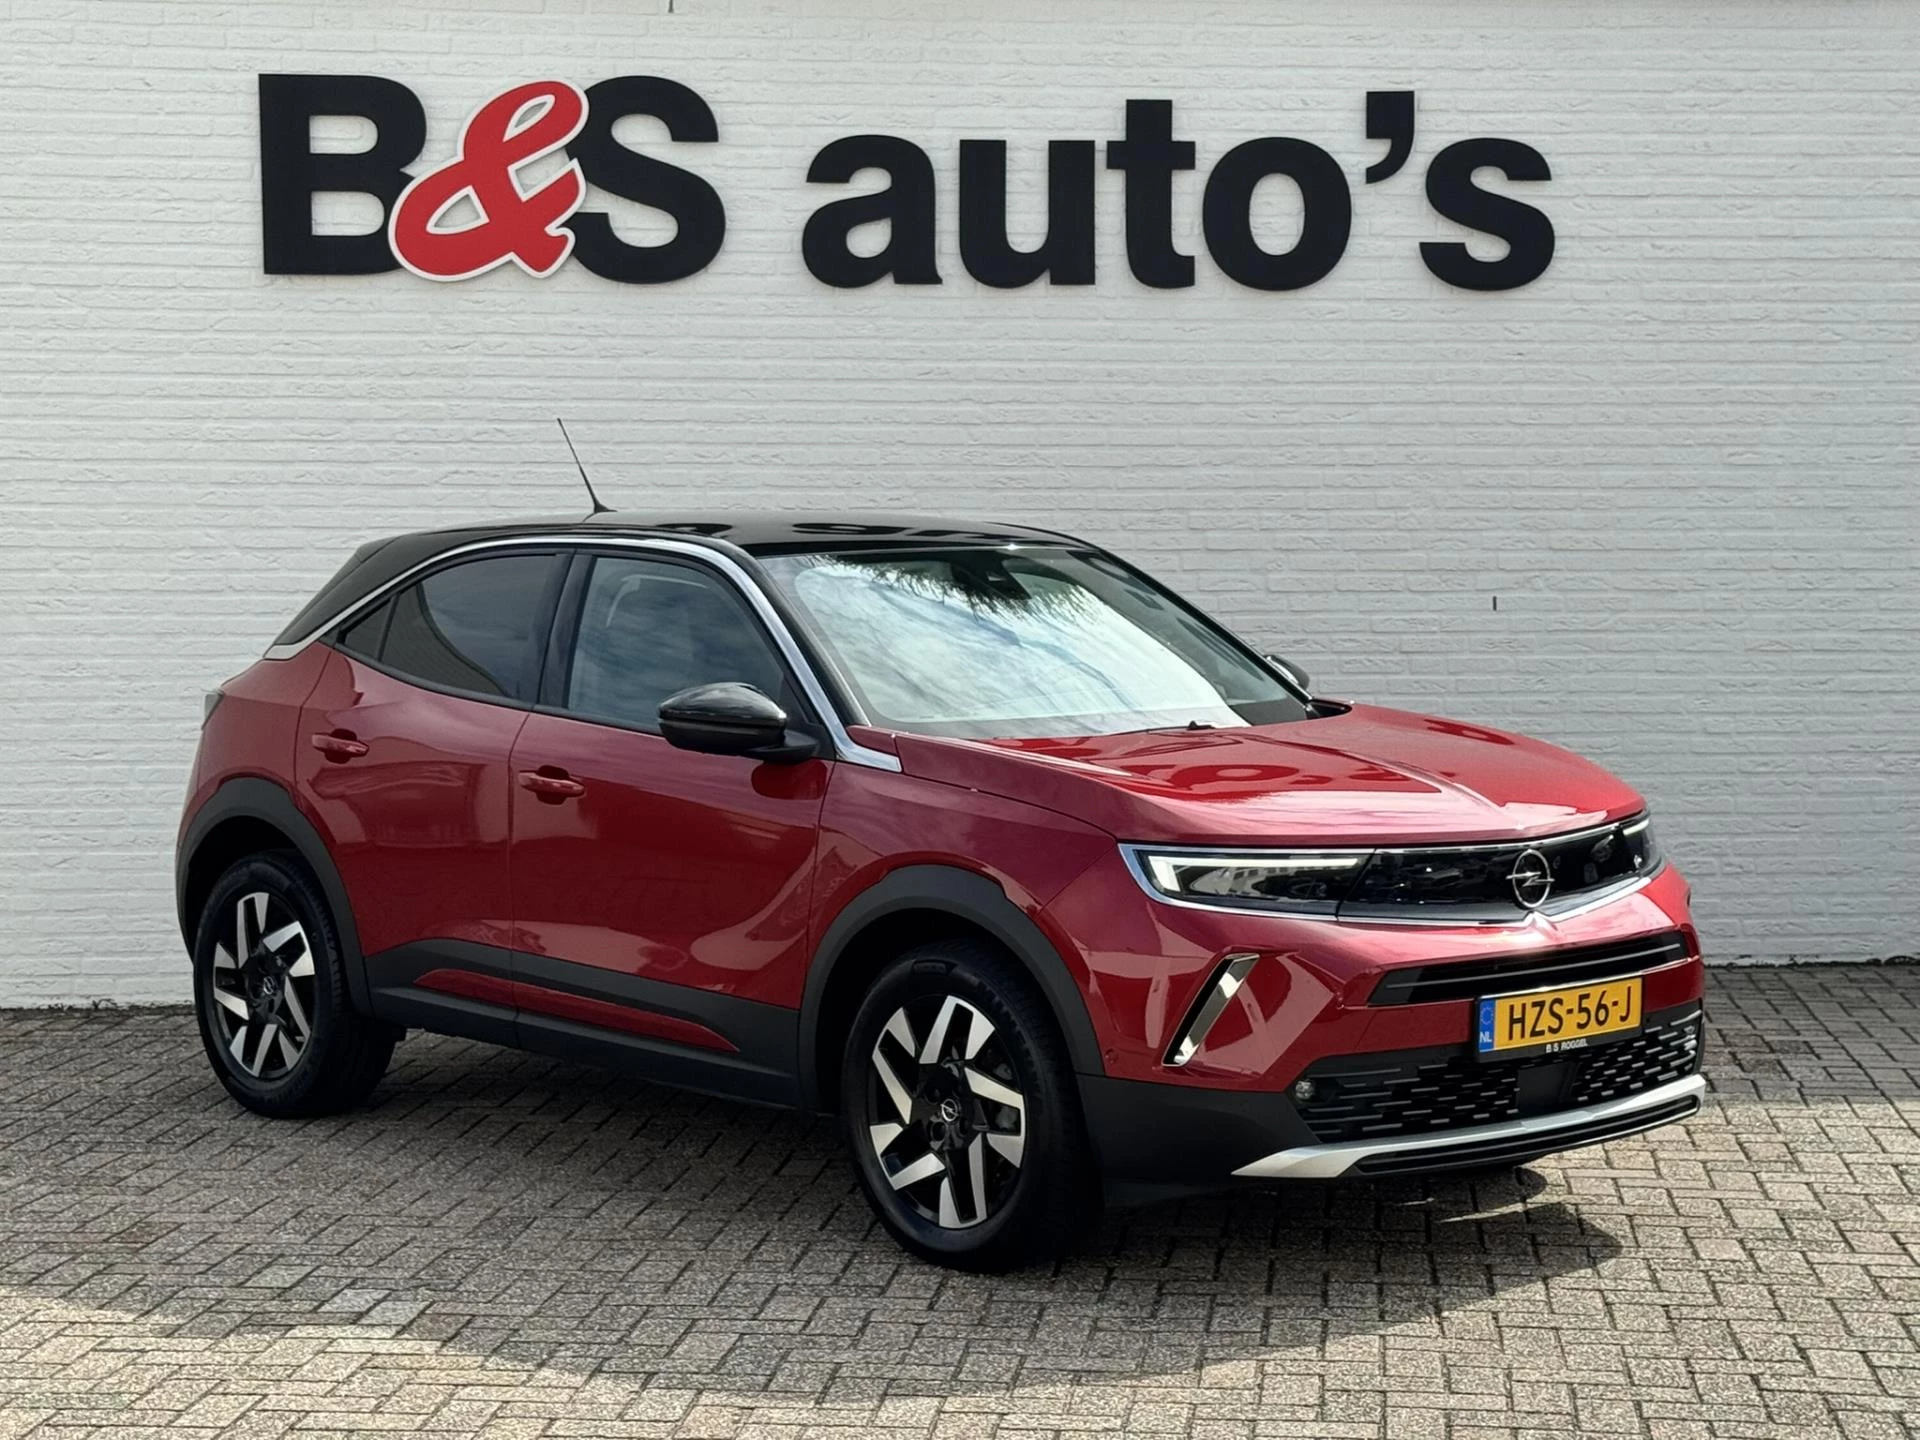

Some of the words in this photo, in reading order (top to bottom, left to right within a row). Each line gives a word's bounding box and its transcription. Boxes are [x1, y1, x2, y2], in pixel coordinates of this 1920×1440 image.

[258, 73, 726, 285] B&S
[801, 90, 1556, 292] auto's
[1479, 1031, 1493, 1043] NL
[1507, 985, 1633, 1041] HZS-56-J
